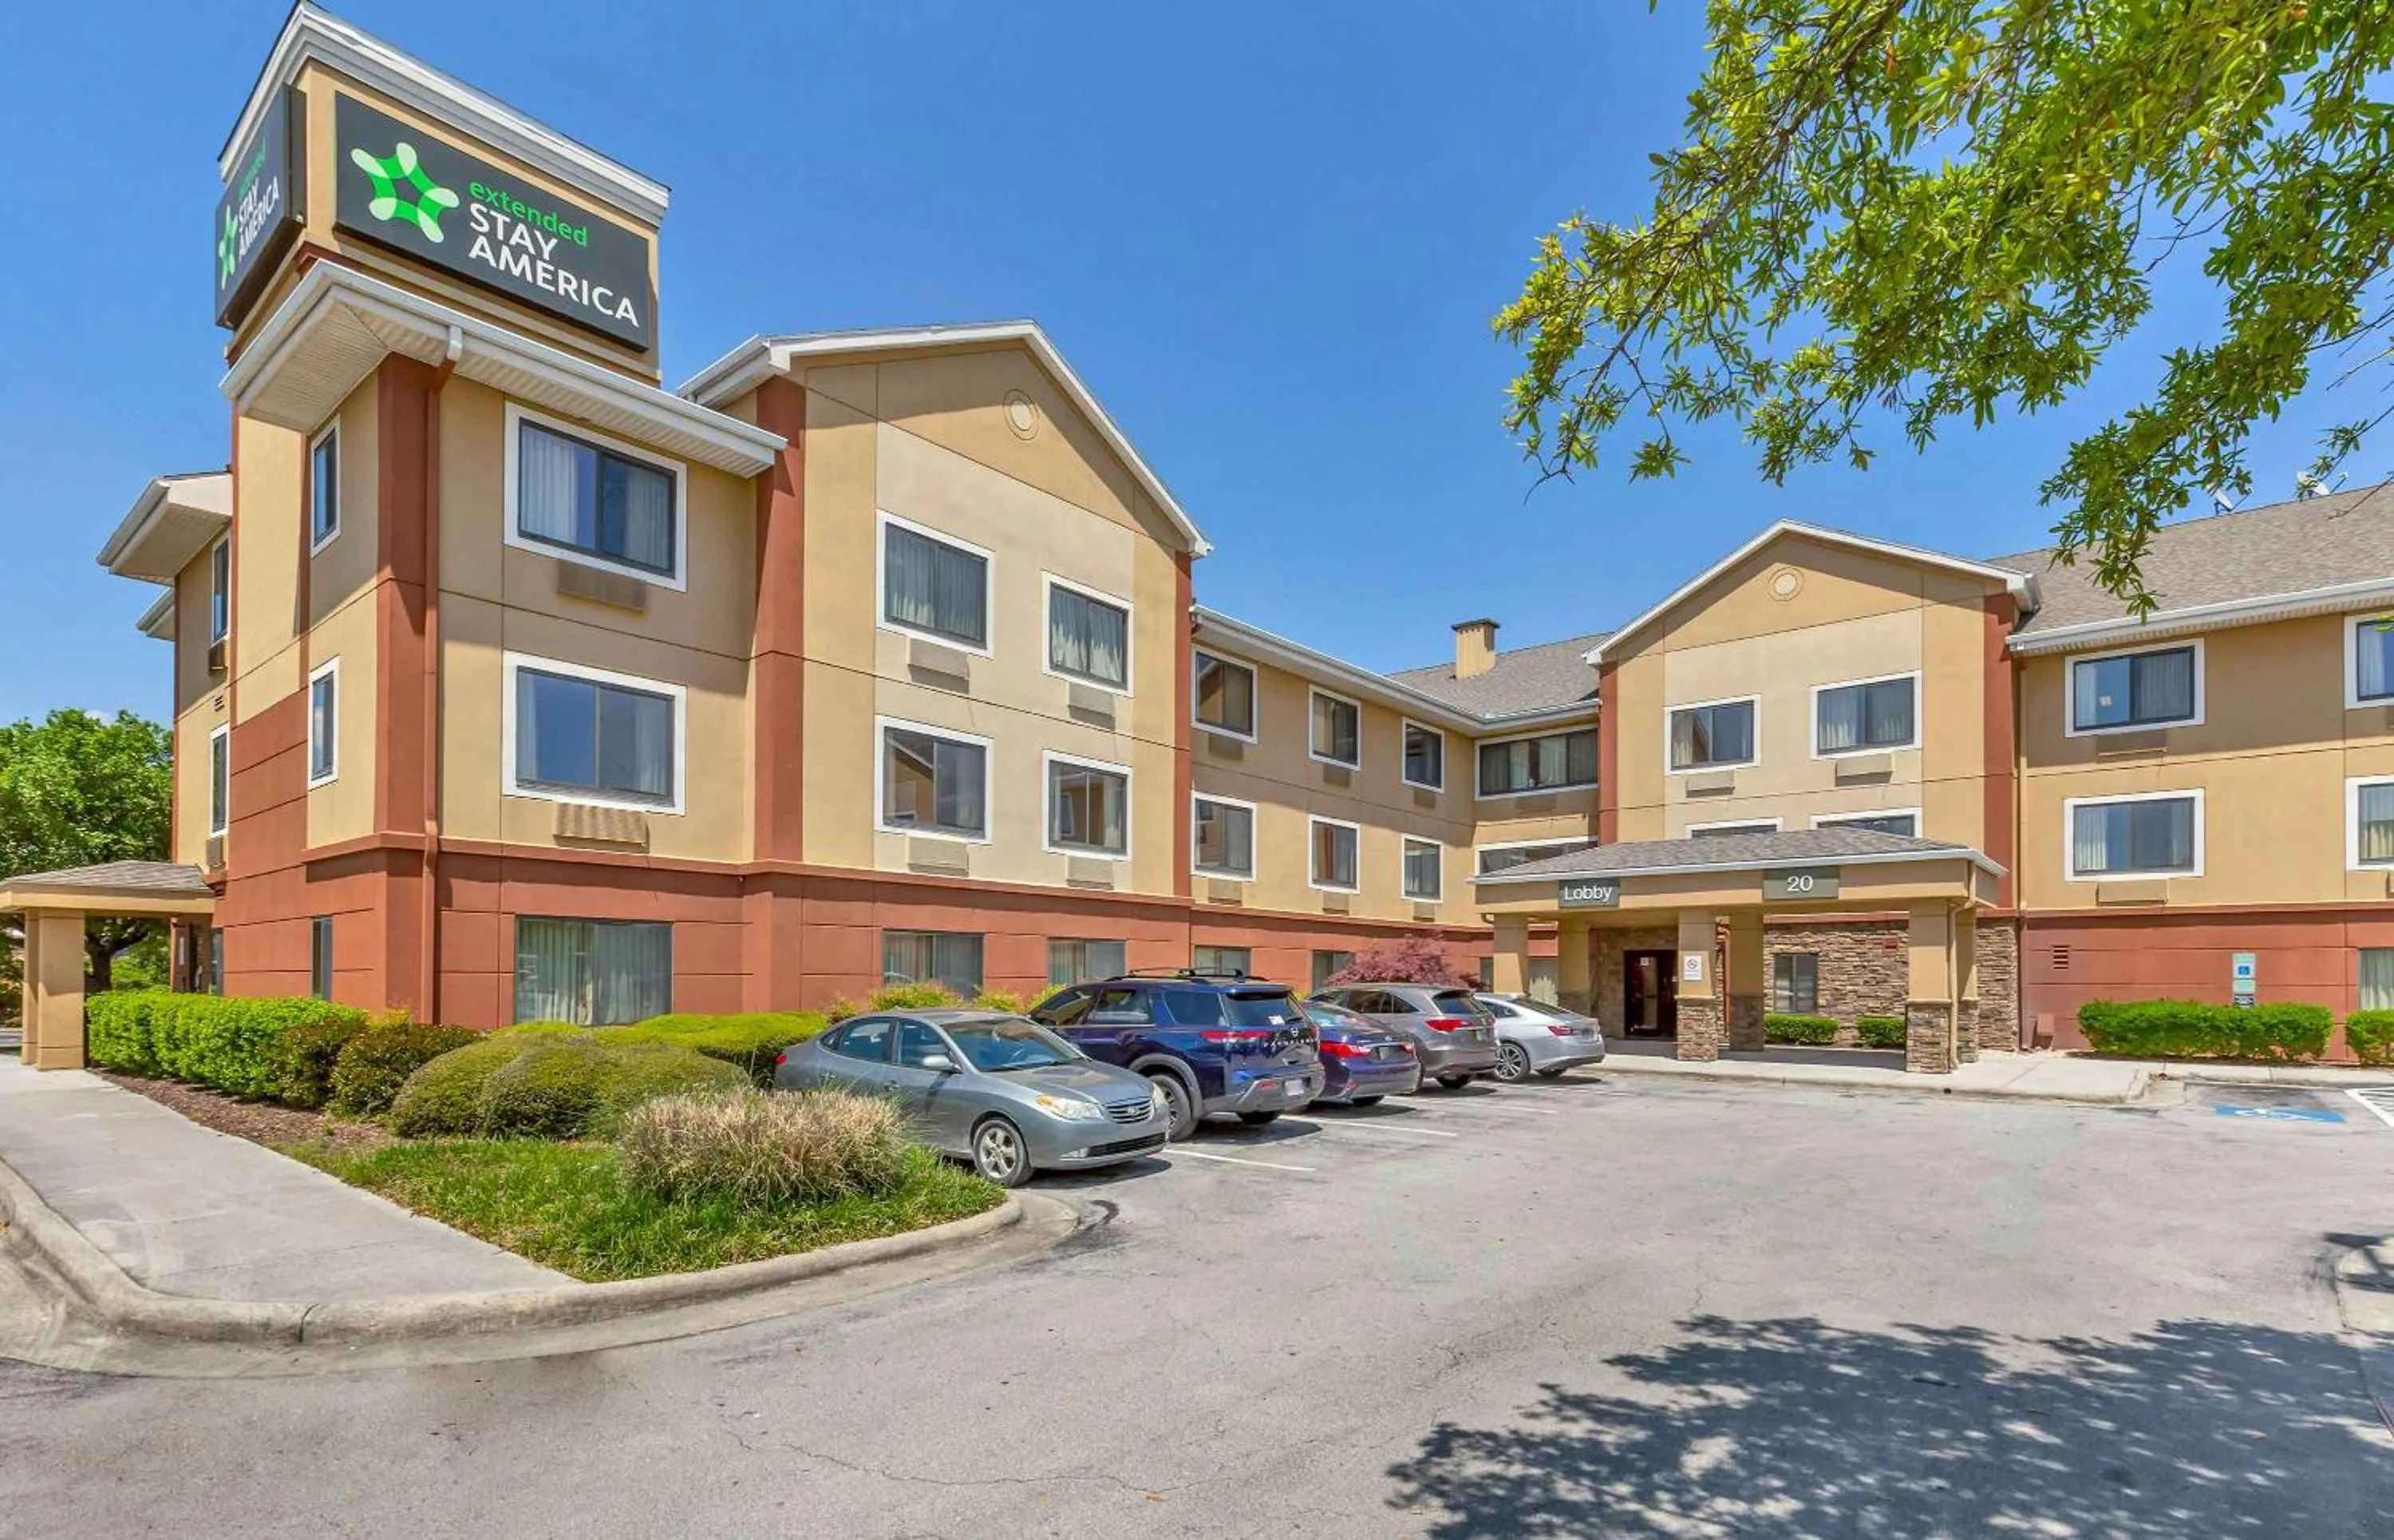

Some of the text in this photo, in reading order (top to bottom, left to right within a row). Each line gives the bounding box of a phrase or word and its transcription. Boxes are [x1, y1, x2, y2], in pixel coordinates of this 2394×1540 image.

[239, 177, 259, 233] STAY
[239, 176, 279, 262] AMERICA
[469, 180, 588, 248] extended
[469, 203, 559, 261] STAY
[468, 235, 639, 328] AMERICA
[1564, 884, 1613, 902] Lobby
[1787, 875, 1813, 891] 20
